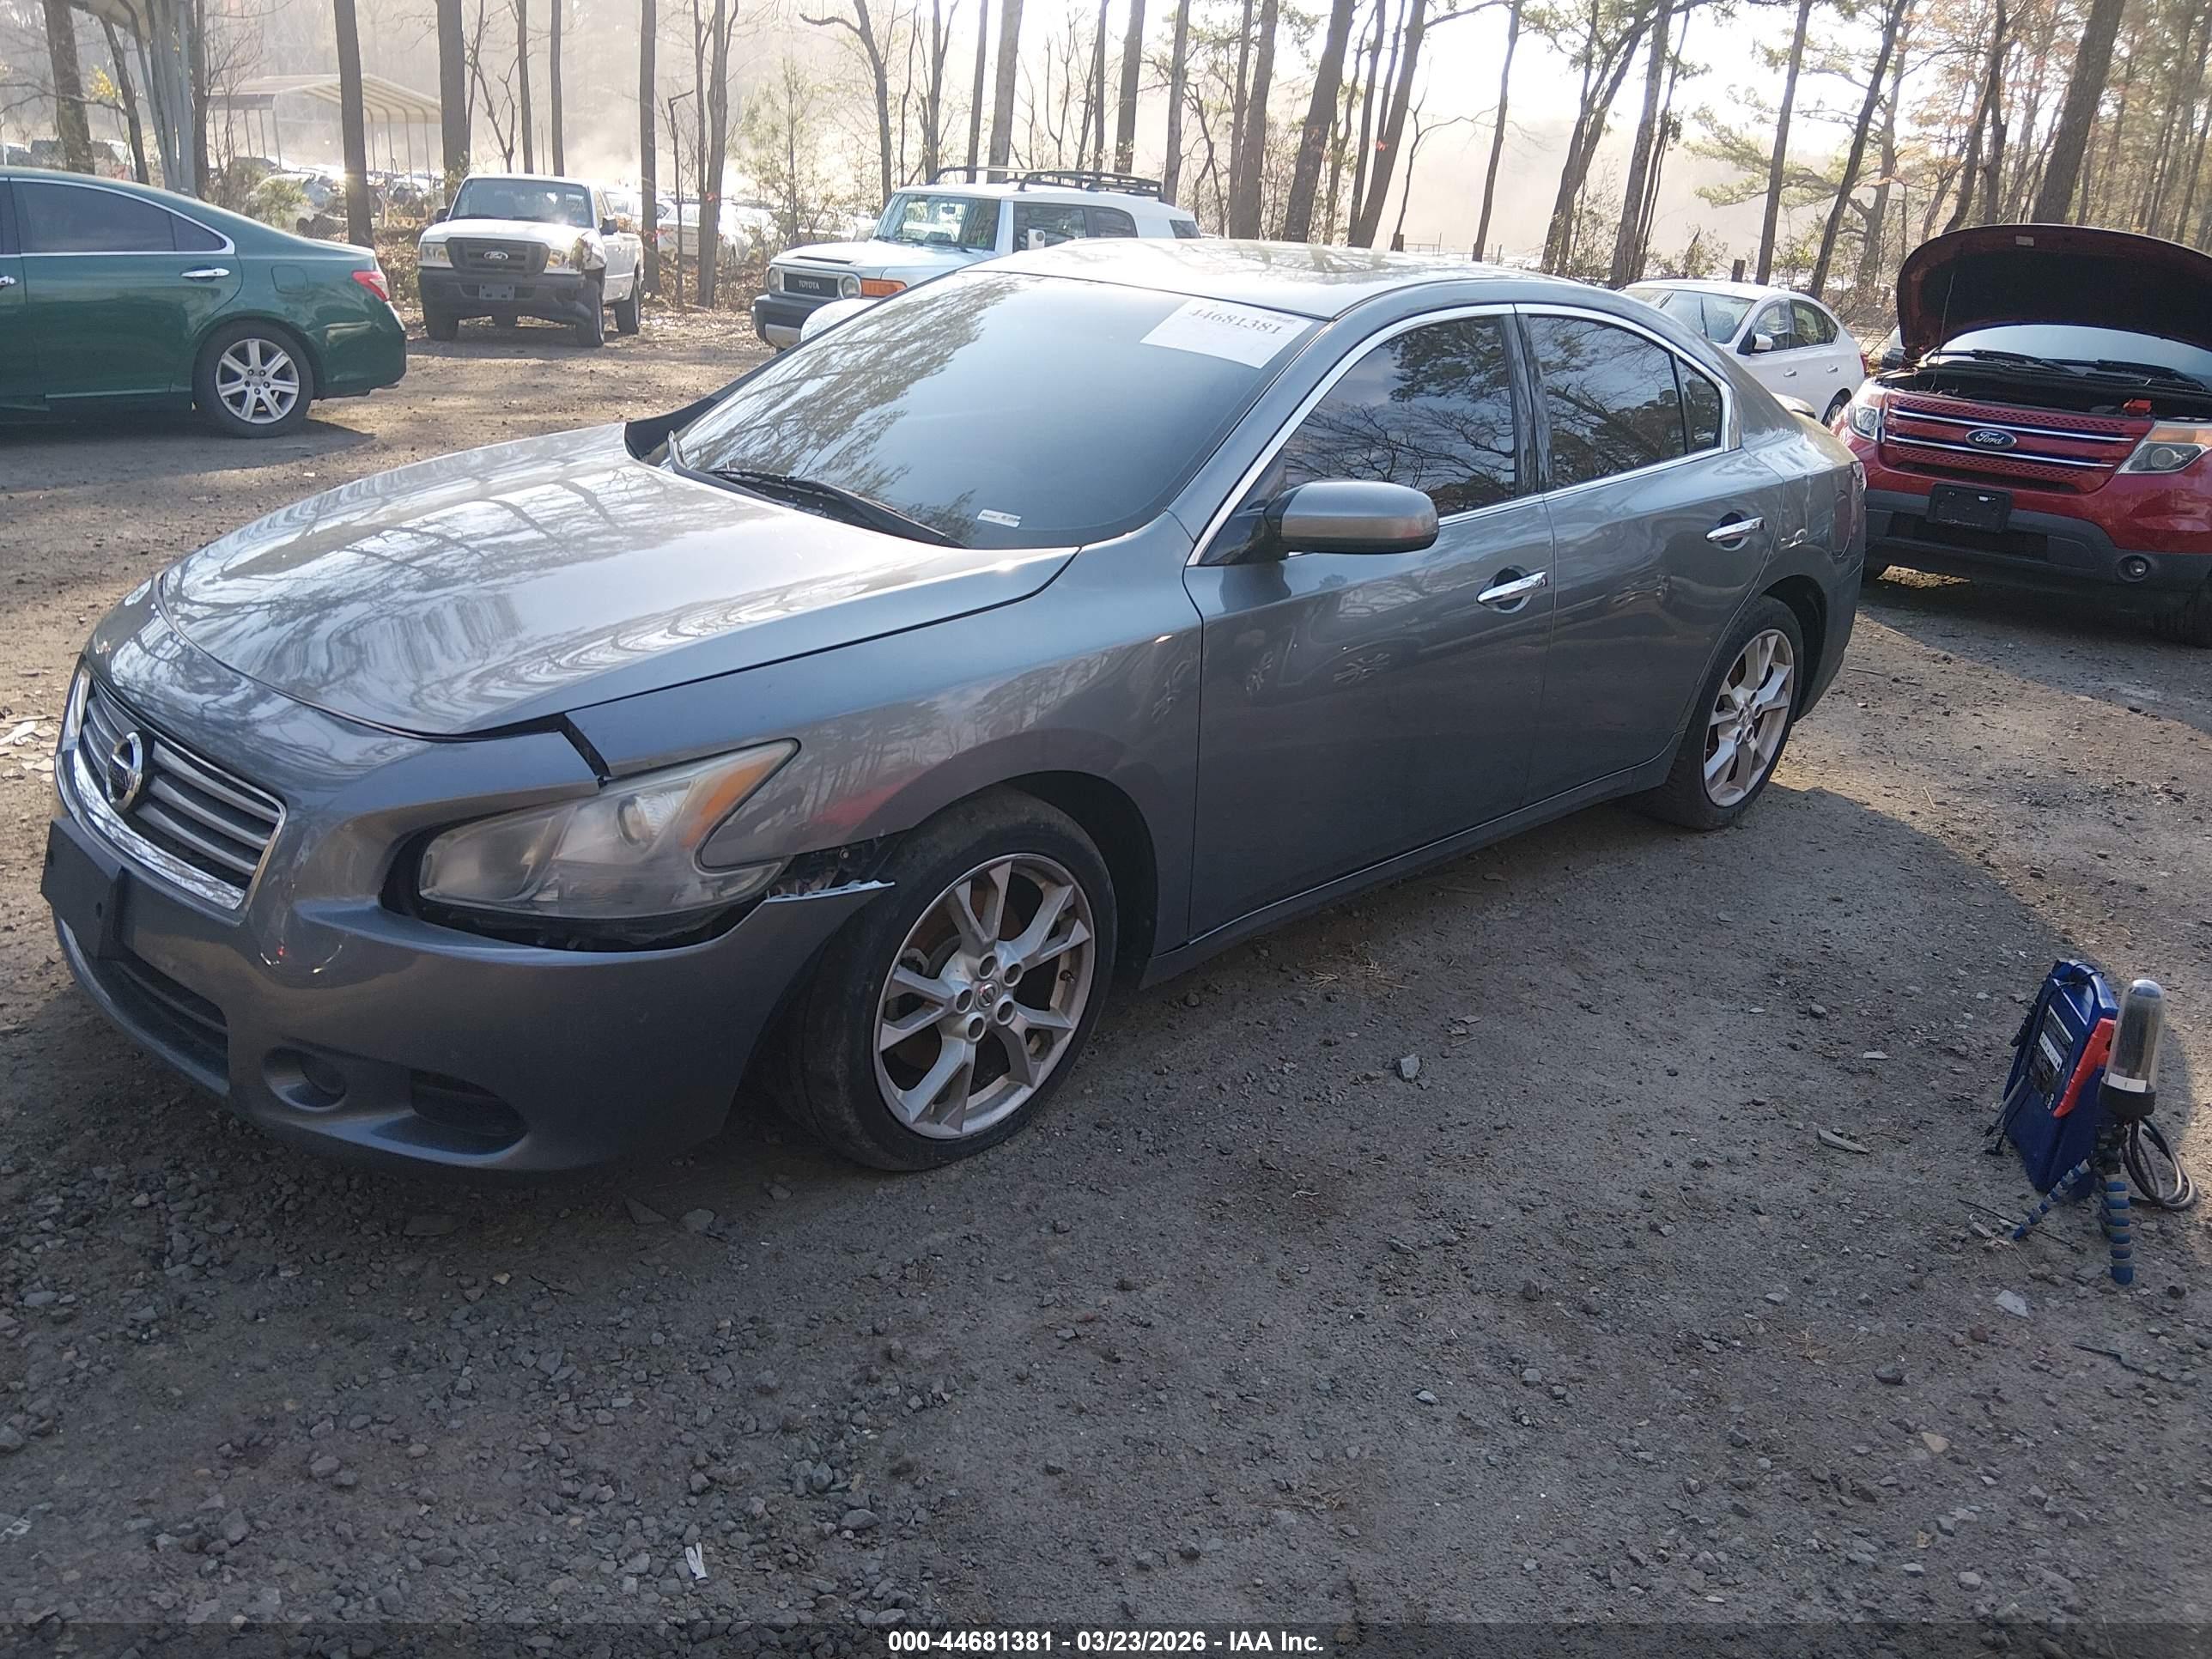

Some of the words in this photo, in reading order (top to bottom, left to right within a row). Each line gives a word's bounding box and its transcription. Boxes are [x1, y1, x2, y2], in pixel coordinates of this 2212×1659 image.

[798, 279, 820, 290] TOYOTA
[1188, 308, 1282, 333] 44681381
[1974, 431, 2005, 445] Ford
